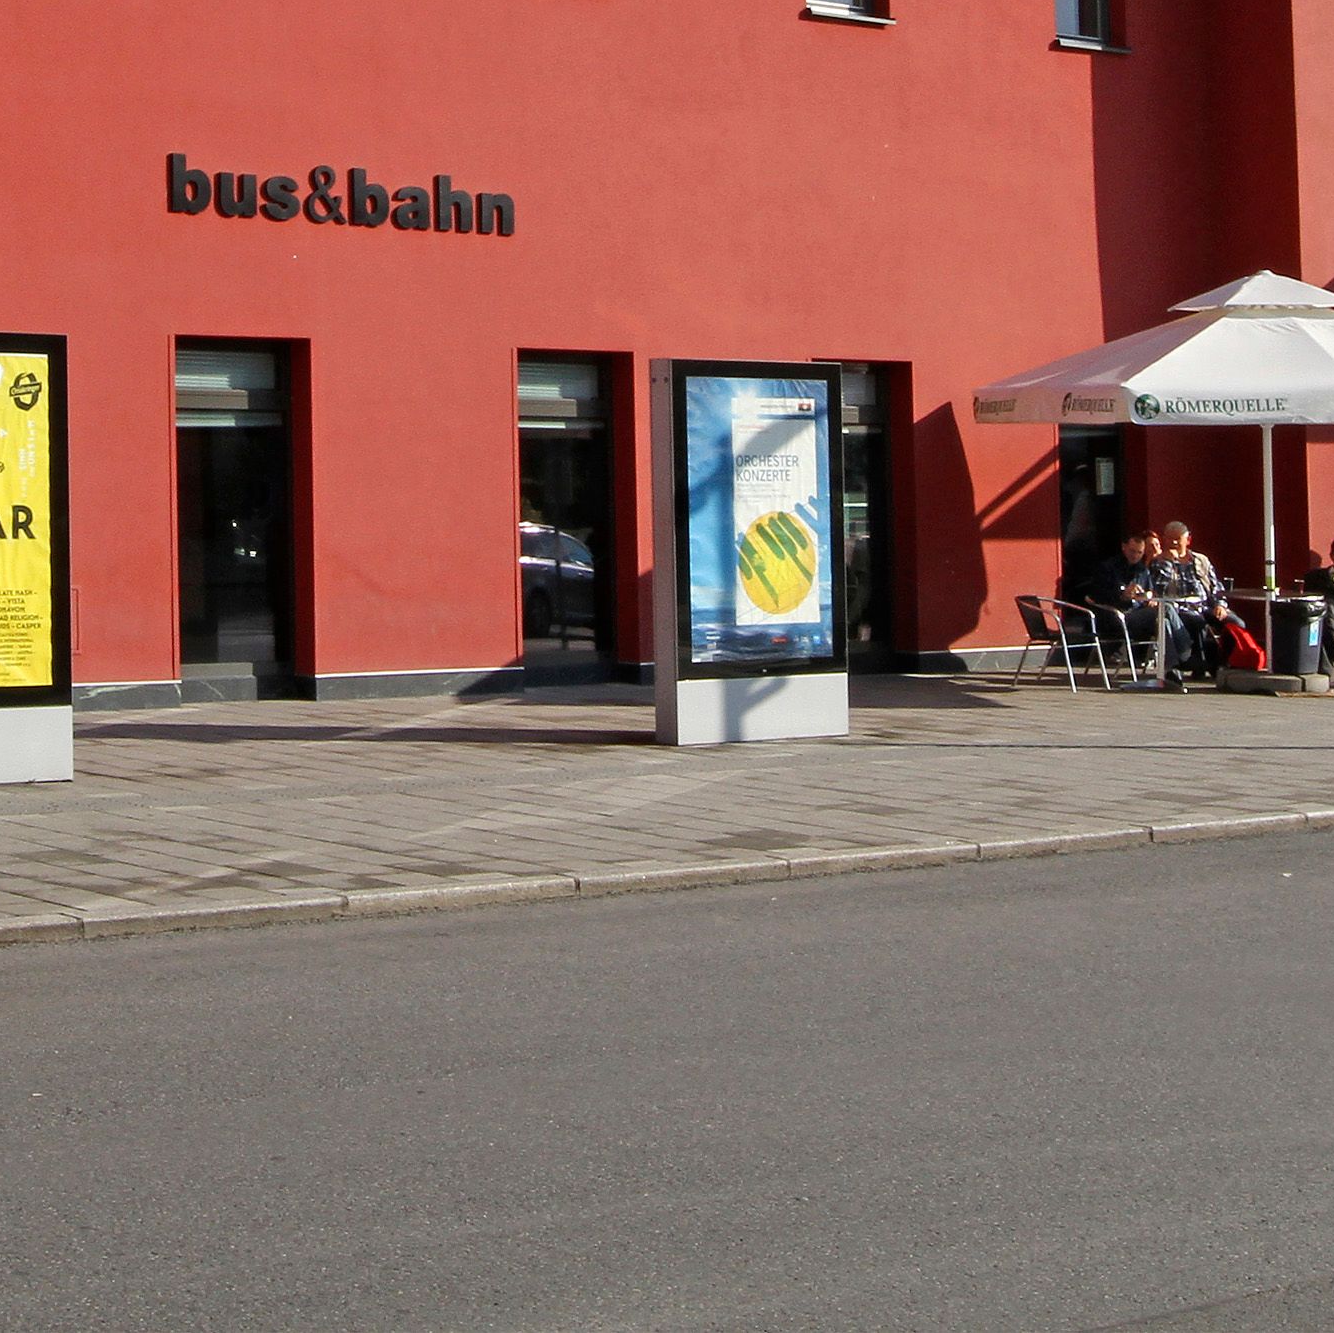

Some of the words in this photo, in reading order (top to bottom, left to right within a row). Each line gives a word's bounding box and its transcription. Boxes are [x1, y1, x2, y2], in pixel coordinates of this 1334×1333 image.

[166, 153, 515, 236] bus&bahn
[1166, 397, 1285, 415] RÖMERQUELLE
[736, 455, 799, 467] ORCHESTER
[736, 469, 791, 481] KONZERTE
